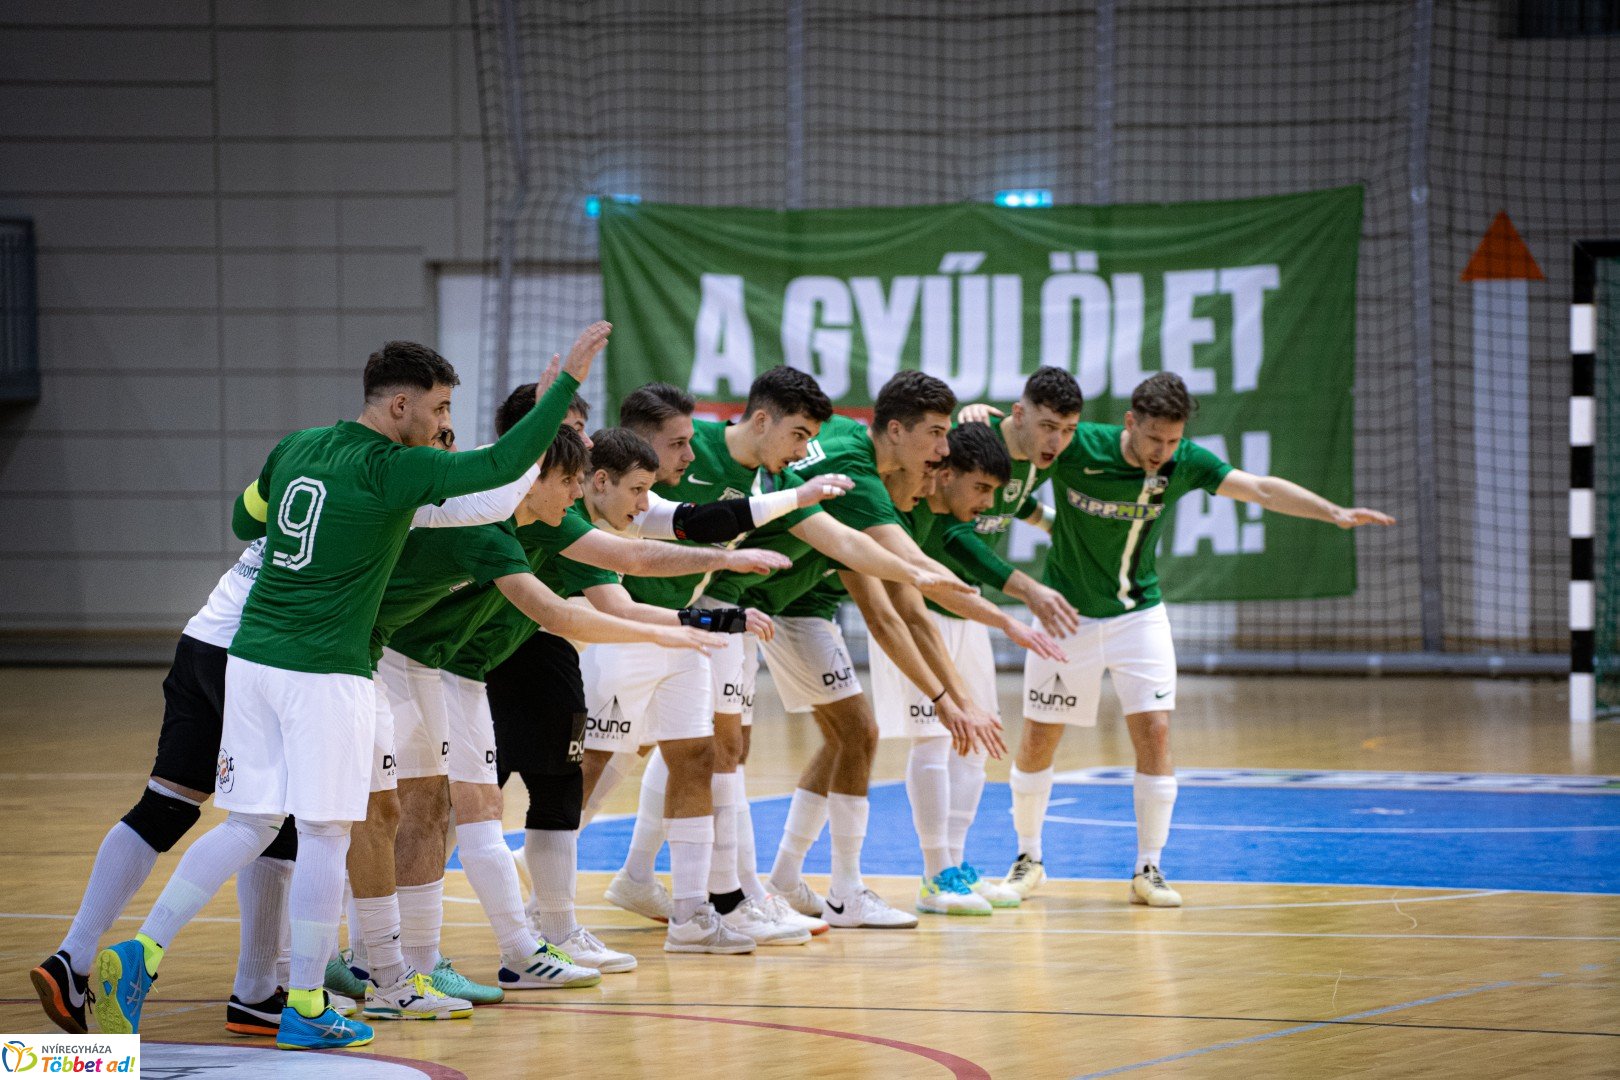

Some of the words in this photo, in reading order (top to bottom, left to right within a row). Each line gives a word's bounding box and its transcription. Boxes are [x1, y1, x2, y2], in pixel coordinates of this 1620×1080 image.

[687, 273, 756, 395] A
[780, 251, 1280, 402] GYŰLÖLET
[273, 476, 327, 571] 9
